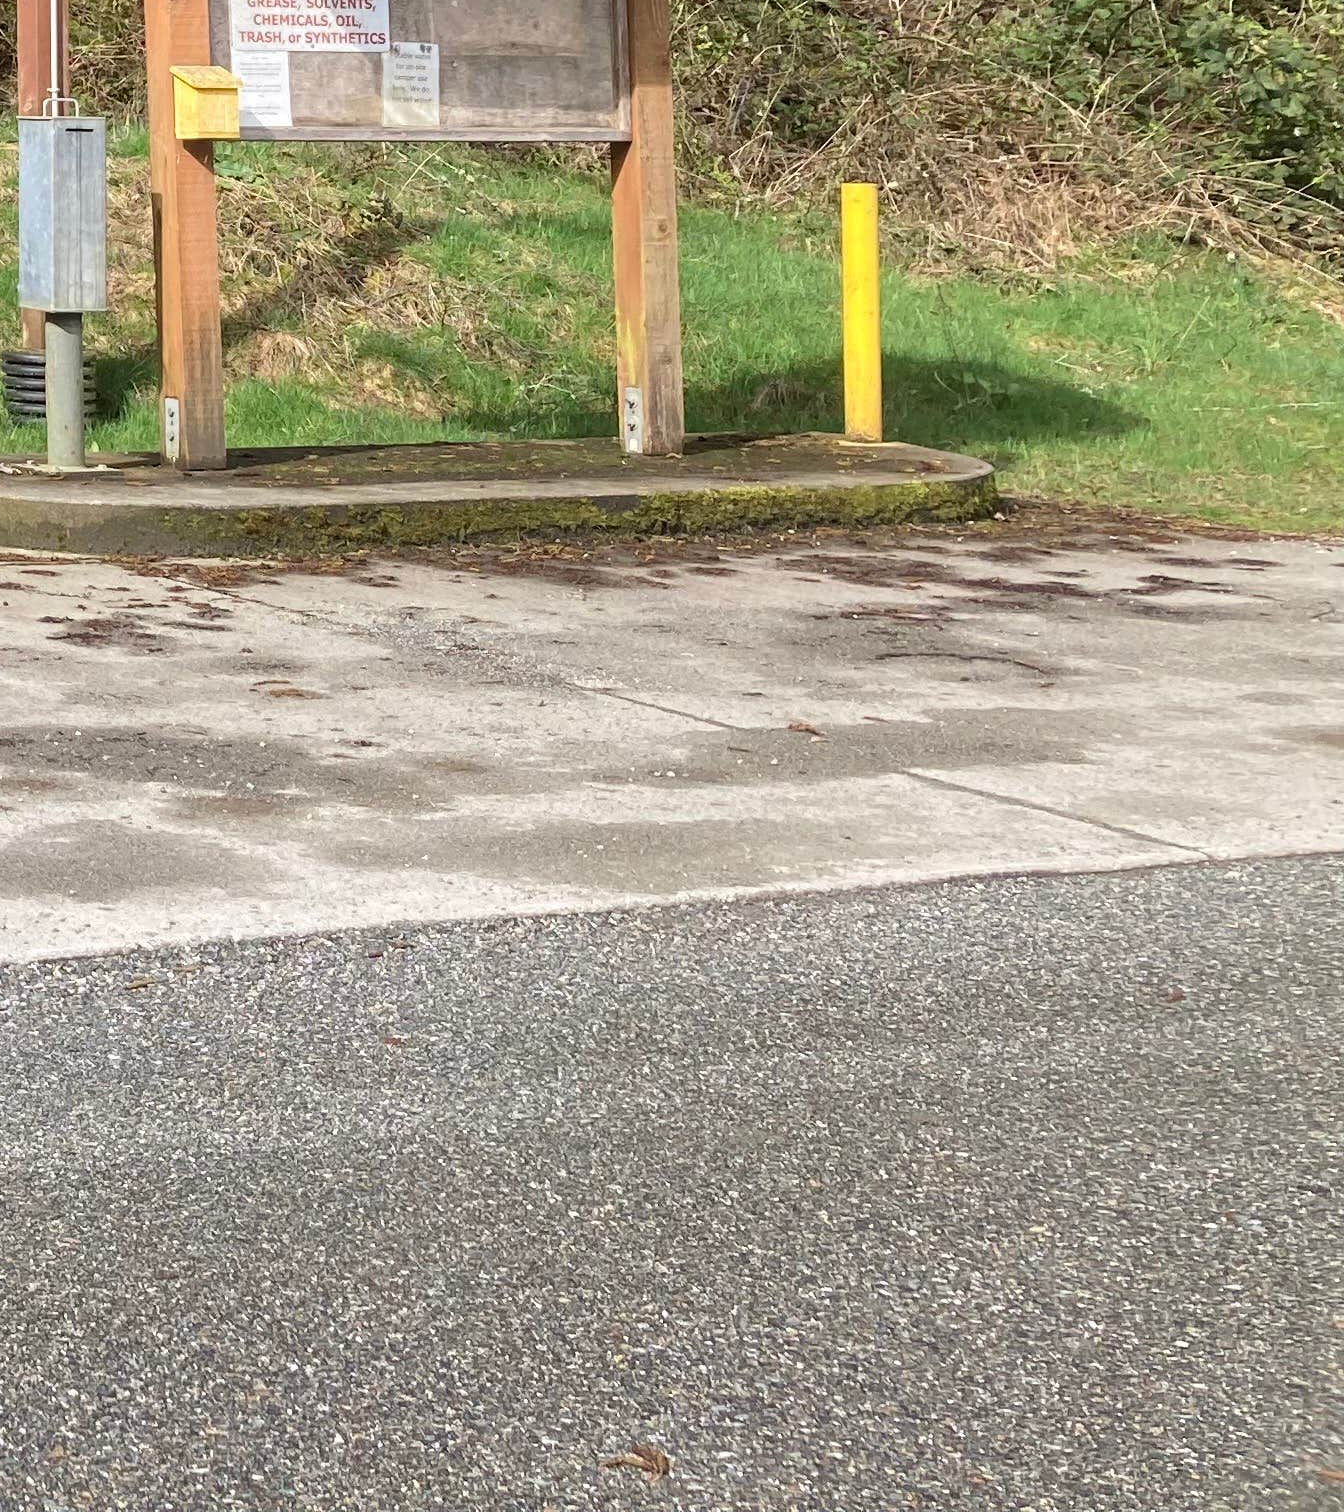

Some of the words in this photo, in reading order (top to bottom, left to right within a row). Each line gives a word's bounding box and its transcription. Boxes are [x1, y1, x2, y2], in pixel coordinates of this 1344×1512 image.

[253, 14, 333, 28] CHEMICALS,
[335, 15, 363, 29] OIL,
[239, 31, 286, 44] TRASH,
[288, 34, 302, 44] or
[304, 33, 386, 45] SYNTHETICS
